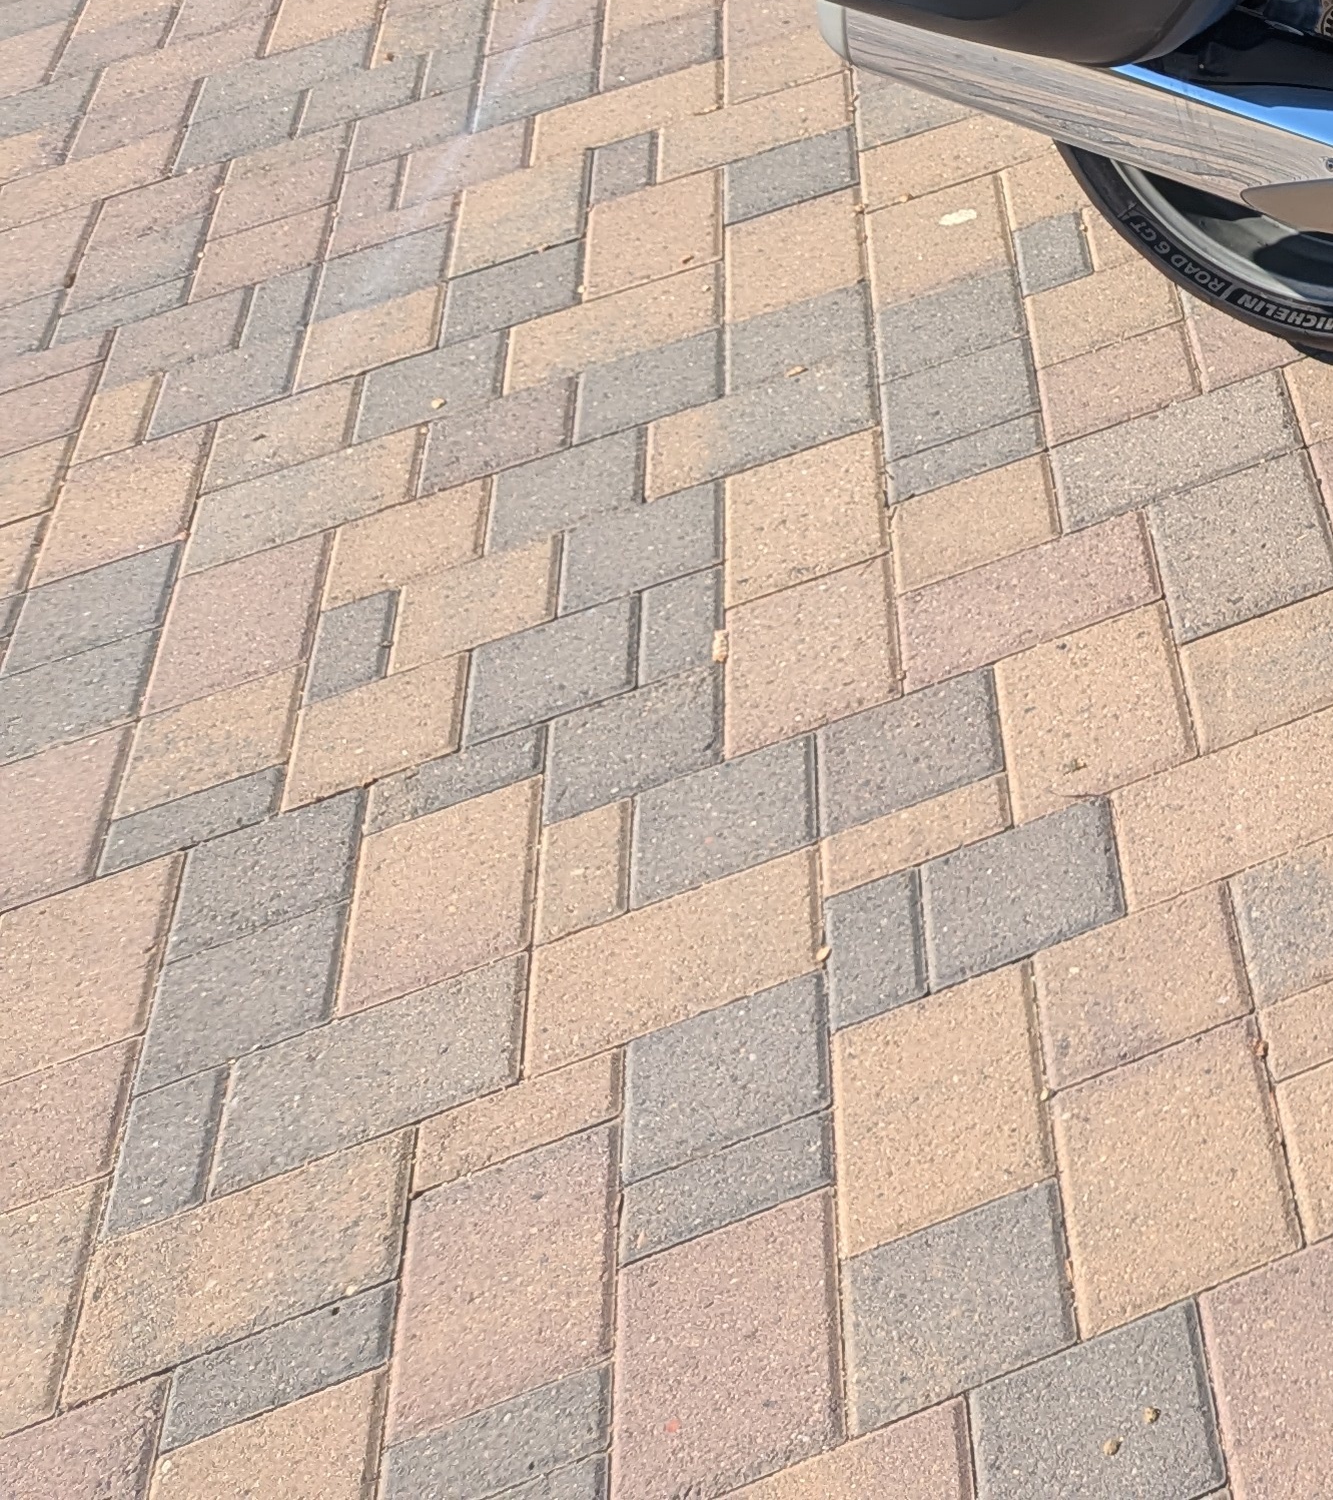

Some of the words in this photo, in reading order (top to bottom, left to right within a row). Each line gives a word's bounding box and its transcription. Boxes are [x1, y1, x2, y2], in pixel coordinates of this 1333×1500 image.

[1129, 220, 1159, 243] GT
[1153, 239, 1171, 254] 6
[1169, 253, 1226, 292] ROAD
